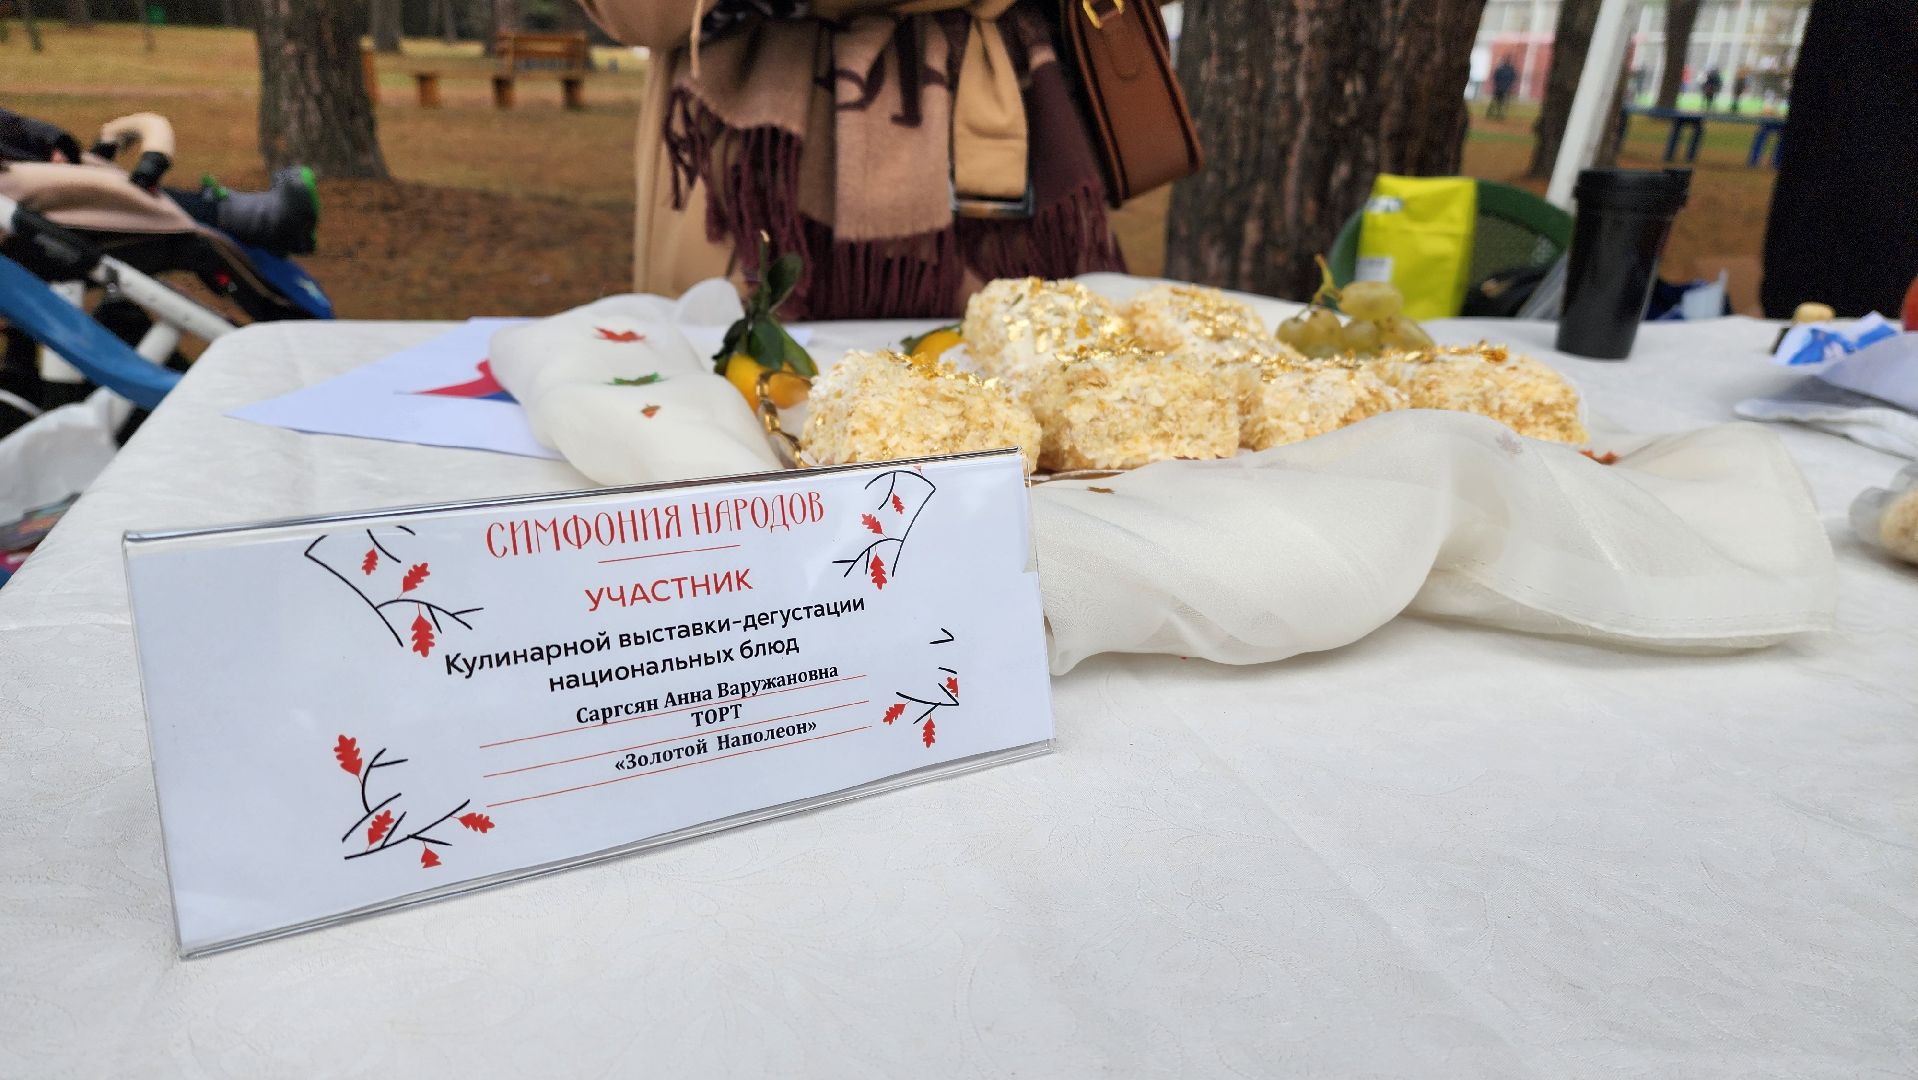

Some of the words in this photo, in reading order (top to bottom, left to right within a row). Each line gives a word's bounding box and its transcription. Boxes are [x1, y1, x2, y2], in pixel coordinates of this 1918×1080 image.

[486, 504, 681, 559] СИМФОНИЯ
[692, 491, 825, 535] НАРОДОВ
[585, 568, 753, 611] УЧАСТНИК
[445, 630, 612, 679] Кулинарной
[618, 596, 865, 650] выставки-дегустации
[549, 646, 734, 692] национальных
[739, 635, 800, 662] блюд
[576, 695, 659, 725] Саргсян
[663, 684, 713, 708] Анна
[717, 664, 839, 697] Варужановна
[691, 702, 742, 728] ТОРТ
[614, 739, 708, 775] «Золотой
[717, 718, 817, 752] Наполеон»
